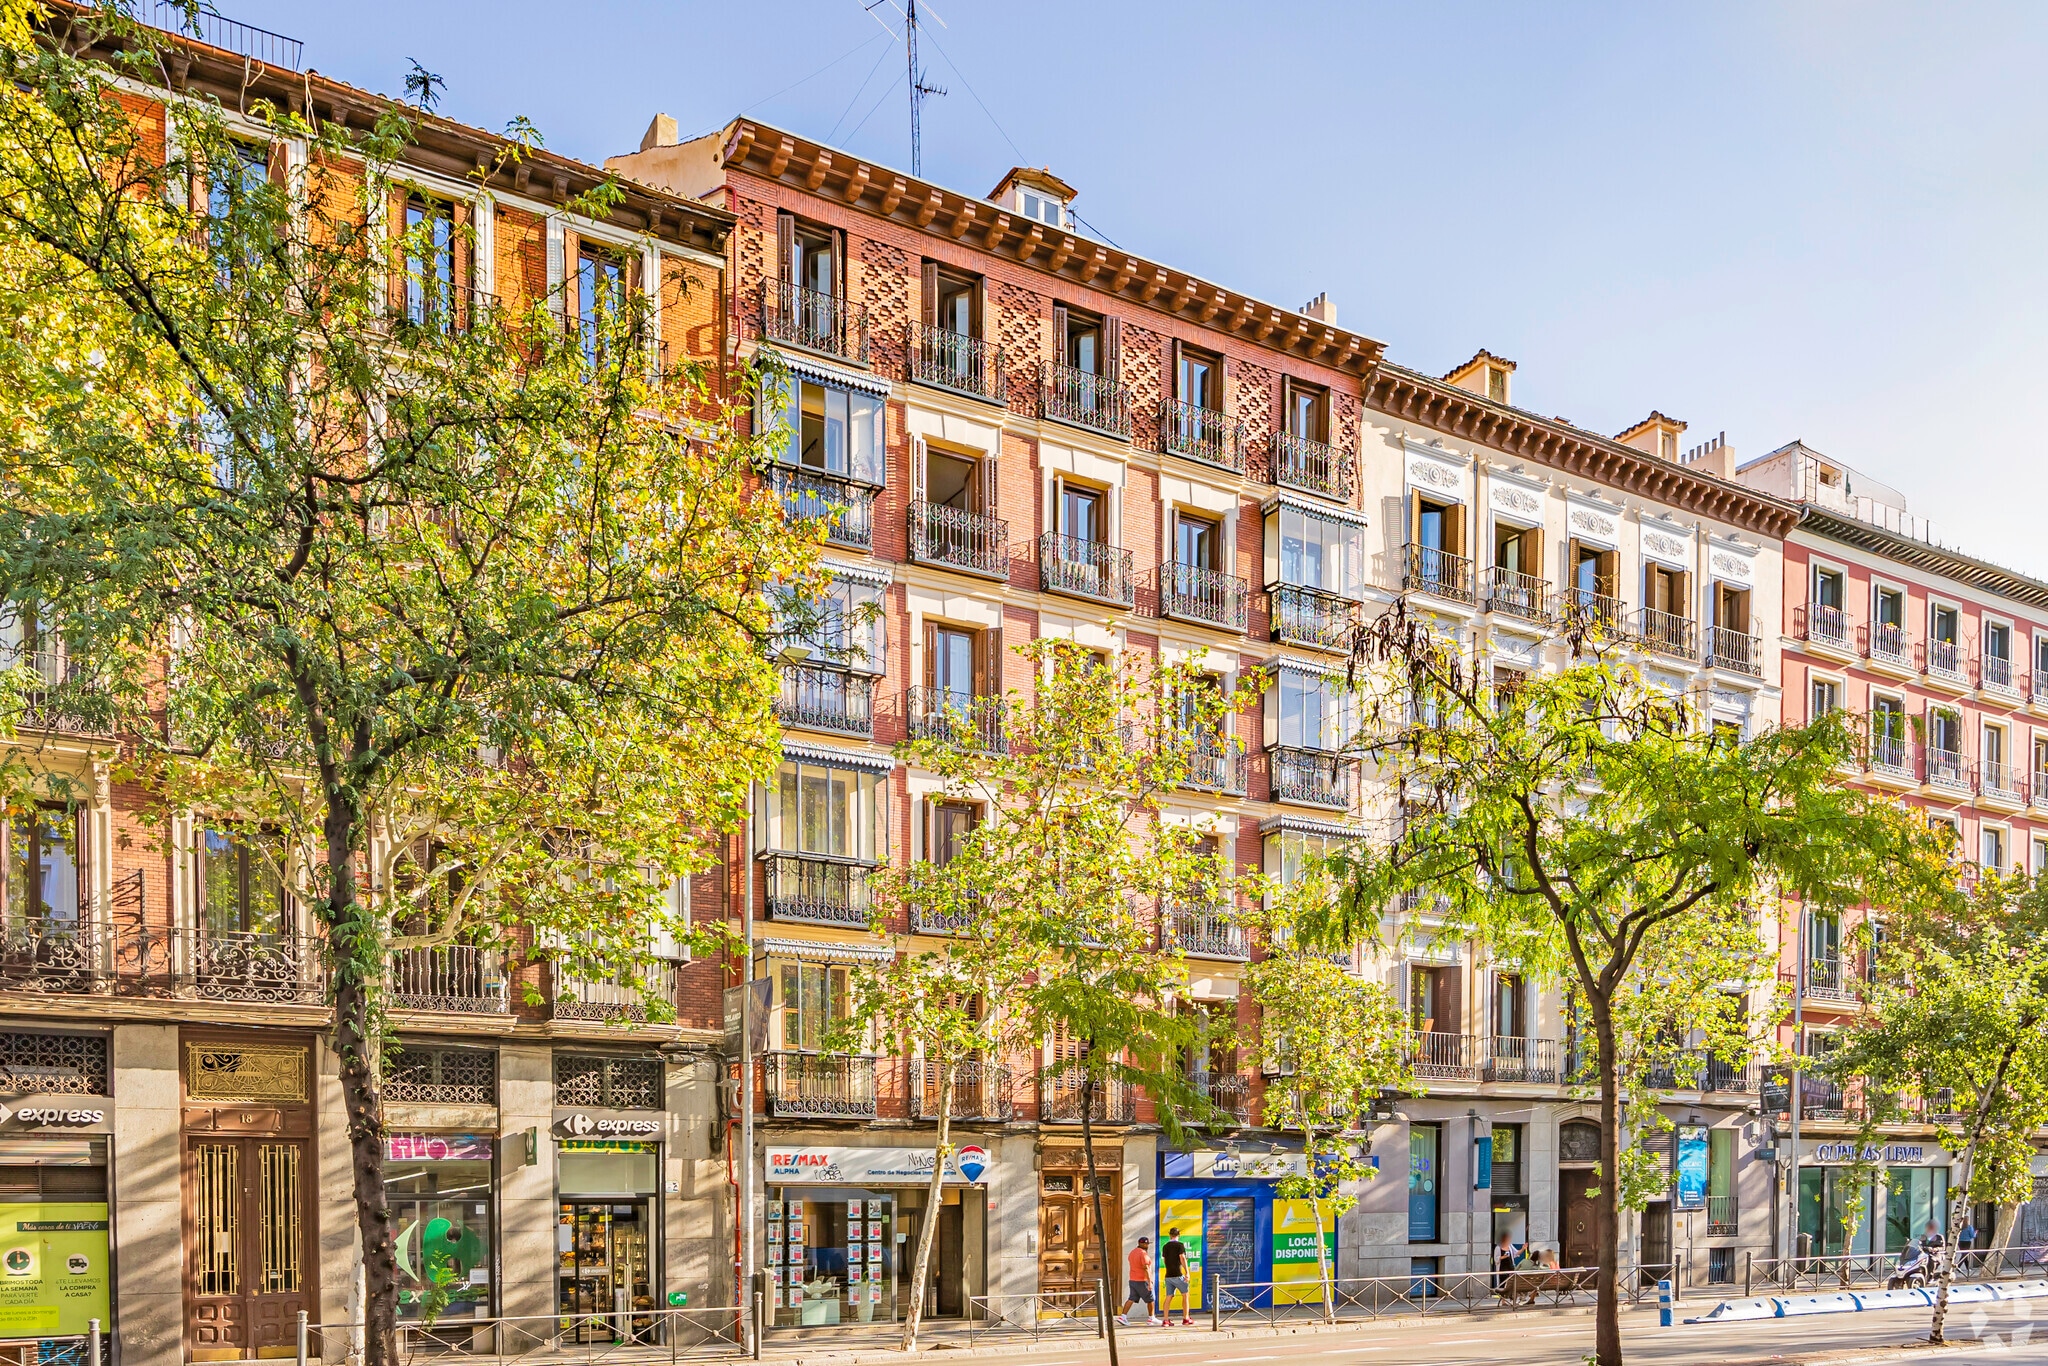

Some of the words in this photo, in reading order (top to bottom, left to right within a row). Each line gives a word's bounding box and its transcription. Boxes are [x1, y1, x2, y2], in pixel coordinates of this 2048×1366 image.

[17, 1108, 104, 1125] express
[240, 1113, 253, 1123] 18
[597, 1119, 660, 1134] express
[1817, 1143, 1881, 1160] CLÍNIAS
[1885, 1146, 1923, 1161] LEVEL
[771, 1154, 828, 1166] RE/MAX
[961, 1155, 984, 1163] RE/MAX
[1275, 1248, 1332, 1258] DISPONIE
